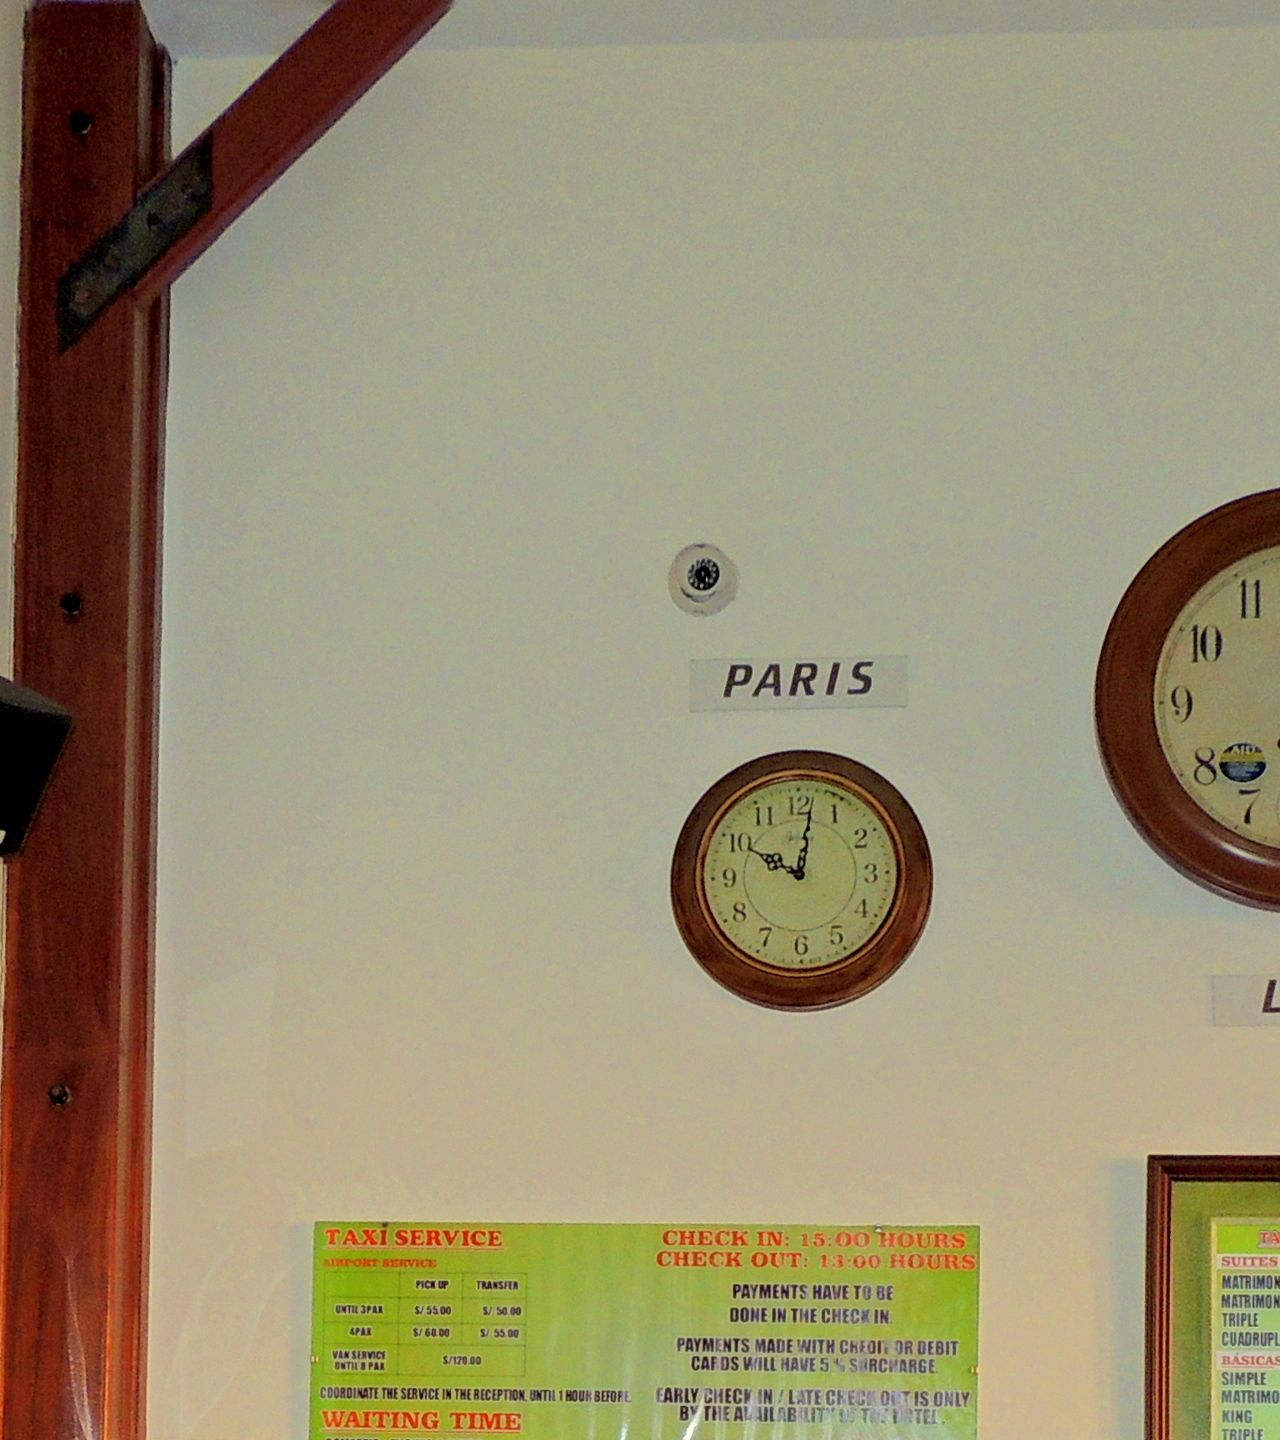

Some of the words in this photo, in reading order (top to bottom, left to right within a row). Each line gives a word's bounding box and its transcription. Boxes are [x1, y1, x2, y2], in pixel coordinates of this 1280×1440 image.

[1240, 580, 1261, 618] 11
[1191, 624, 1223, 662] 10
[723, 661, 873, 698] PARIS
[1171, 686, 1192, 722] 9
[1193, 747, 1217, 785] 8
[789, 797, 809, 815] 12
[831, 805, 838, 823] 1
[1239, 789, 1260, 824] 7
[755, 806, 773, 825] 11
[729, 833, 751, 852] 10
[854, 829, 867, 848] 2
[723, 869, 736, 887] 9
[865, 865, 878, 883] 3
[733, 903, 746, 922] 8
[855, 899, 868, 918] 4
[759, 927, 772, 947] 7
[830, 926, 844, 945] 5
[795, 936, 808, 955] 6
[325, 1229, 388, 1245] TAXI
[395, 1230, 502, 1246] SERVICE
[662, 1231, 748, 1246] CHECK
[757, 1231, 789, 1246] IN:
[801, 1232, 870, 1247] 15:00
[879, 1232, 966, 1248] HOURS
[656, 1252, 743, 1267] CHECK
[751, 1252, 808, 1268] OUT:
[820, 1254, 881, 1268] 13:00
[889, 1255, 976, 1270] HOURS
[1221, 1256, 1278, 1266] SUITES
[416, 1280, 436, 1289] PICK
[438, 1281, 448, 1289] UP
[477, 1281, 518, 1290] TRANSFER
[733, 1284, 808, 1300] PAYMENTS
[813, 1285, 848, 1300] HAVE
[854, 1285, 871, 1300] TO
[877, 1285, 893, 1300] BE
[730, 1307, 767, 1322] DONE
[772, 1308, 786, 1322] IN
[791, 1308, 817, 1323] THE
[821, 1309, 870, 1323] CHECK
[1222, 1313, 1258, 1327] TRIPLE
[677, 1338, 750, 1352] PAYMENTS
[755, 1338, 792, 1353] MADE
[797, 1339, 834, 1354] WITH
[918, 1341, 958, 1356] DEBIT
[1221, 1373, 1266, 1385] SIMPLE
[320, 1388, 378, 1399] COORDINATE
[382, 1388, 398, 1399] THE
[401, 1388, 439, 1400] SERVICE
[442, 1389, 451, 1400] IN
[455, 1389, 471, 1400] THE
[530, 1390, 555, 1401] UNTIL
[559, 1390, 563, 1401] 1
[566, 1390, 591, 1401] HOUR
[323, 1411, 439, 1429] WAITING
[450, 1413, 521, 1430] TIME
[1222, 1410, 1252, 1423] KING
